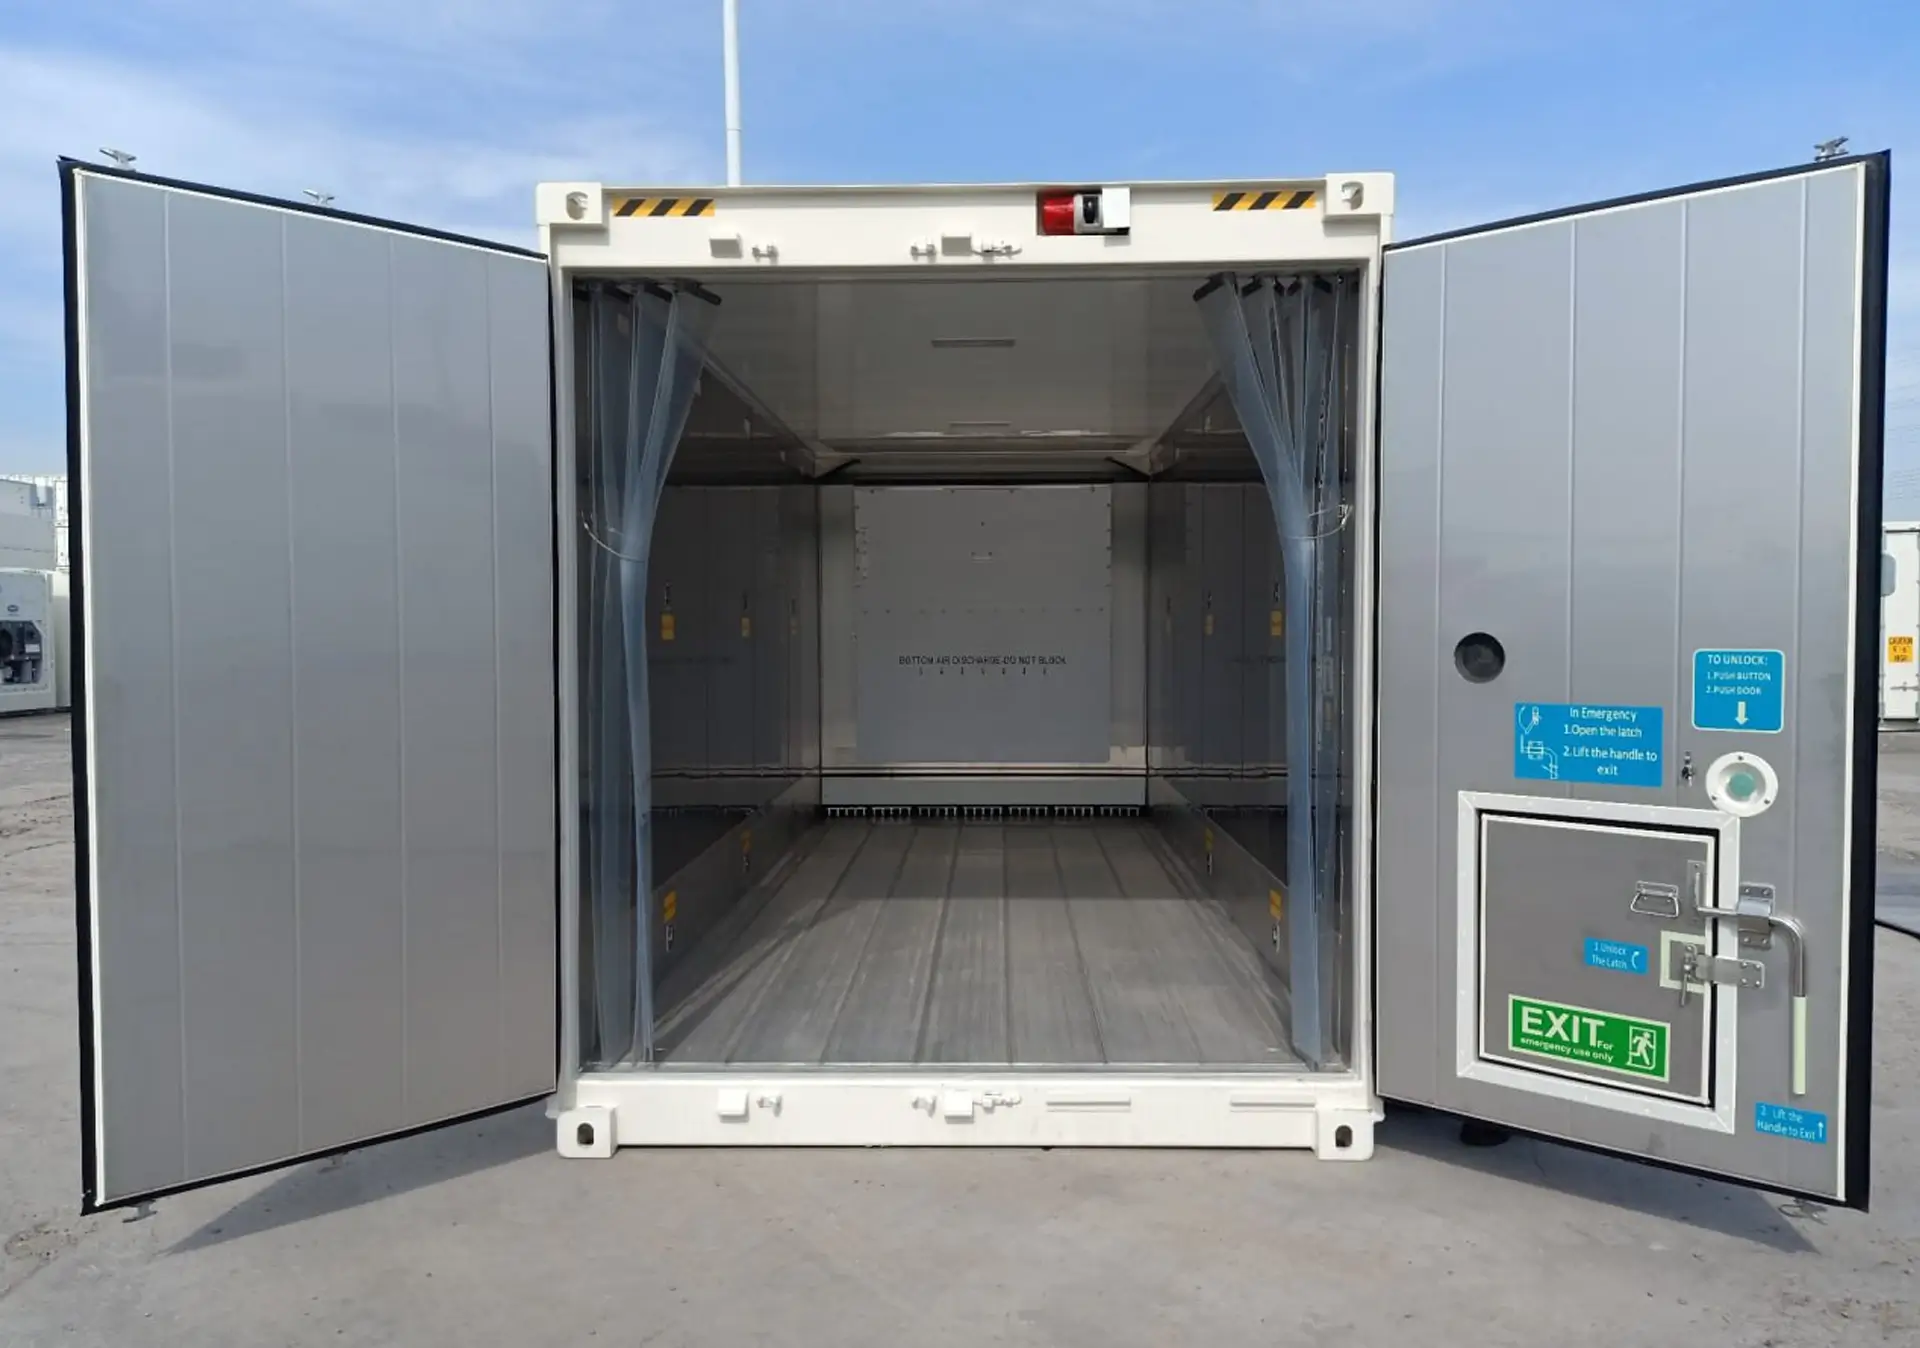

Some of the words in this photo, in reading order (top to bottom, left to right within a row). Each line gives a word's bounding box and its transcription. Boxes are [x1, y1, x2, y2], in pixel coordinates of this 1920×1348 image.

[899, 655, 934, 665] BOTTOM
[936, 655, 951, 665] AIR
[1019, 655, 1036, 665] NOT
[1038, 655, 1067, 665] BLOCK
[1708, 654, 1721, 664] TO
[1736, 671, 1772, 681] BUTTON
[1737, 686, 1762, 696] DOOR
[1570, 707, 1580, 718] In
[1582, 707, 1638, 723] Emergency
[1600, 725, 1617, 736] the
[1618, 726, 1643, 738] latch
[1591, 746, 1609, 759] the
[1610, 747, 1645, 760] handle
[1646, 751, 1658, 763] to
[1597, 765, 1619, 776] exit
[1521, 1005, 1606, 1047] EXIT
[1597, 1040, 1614, 1051] For
[1520, 1037, 1571, 1055] emergency
[1573, 1047, 1591, 1058] use
[1592, 1050, 1614, 1063] only
